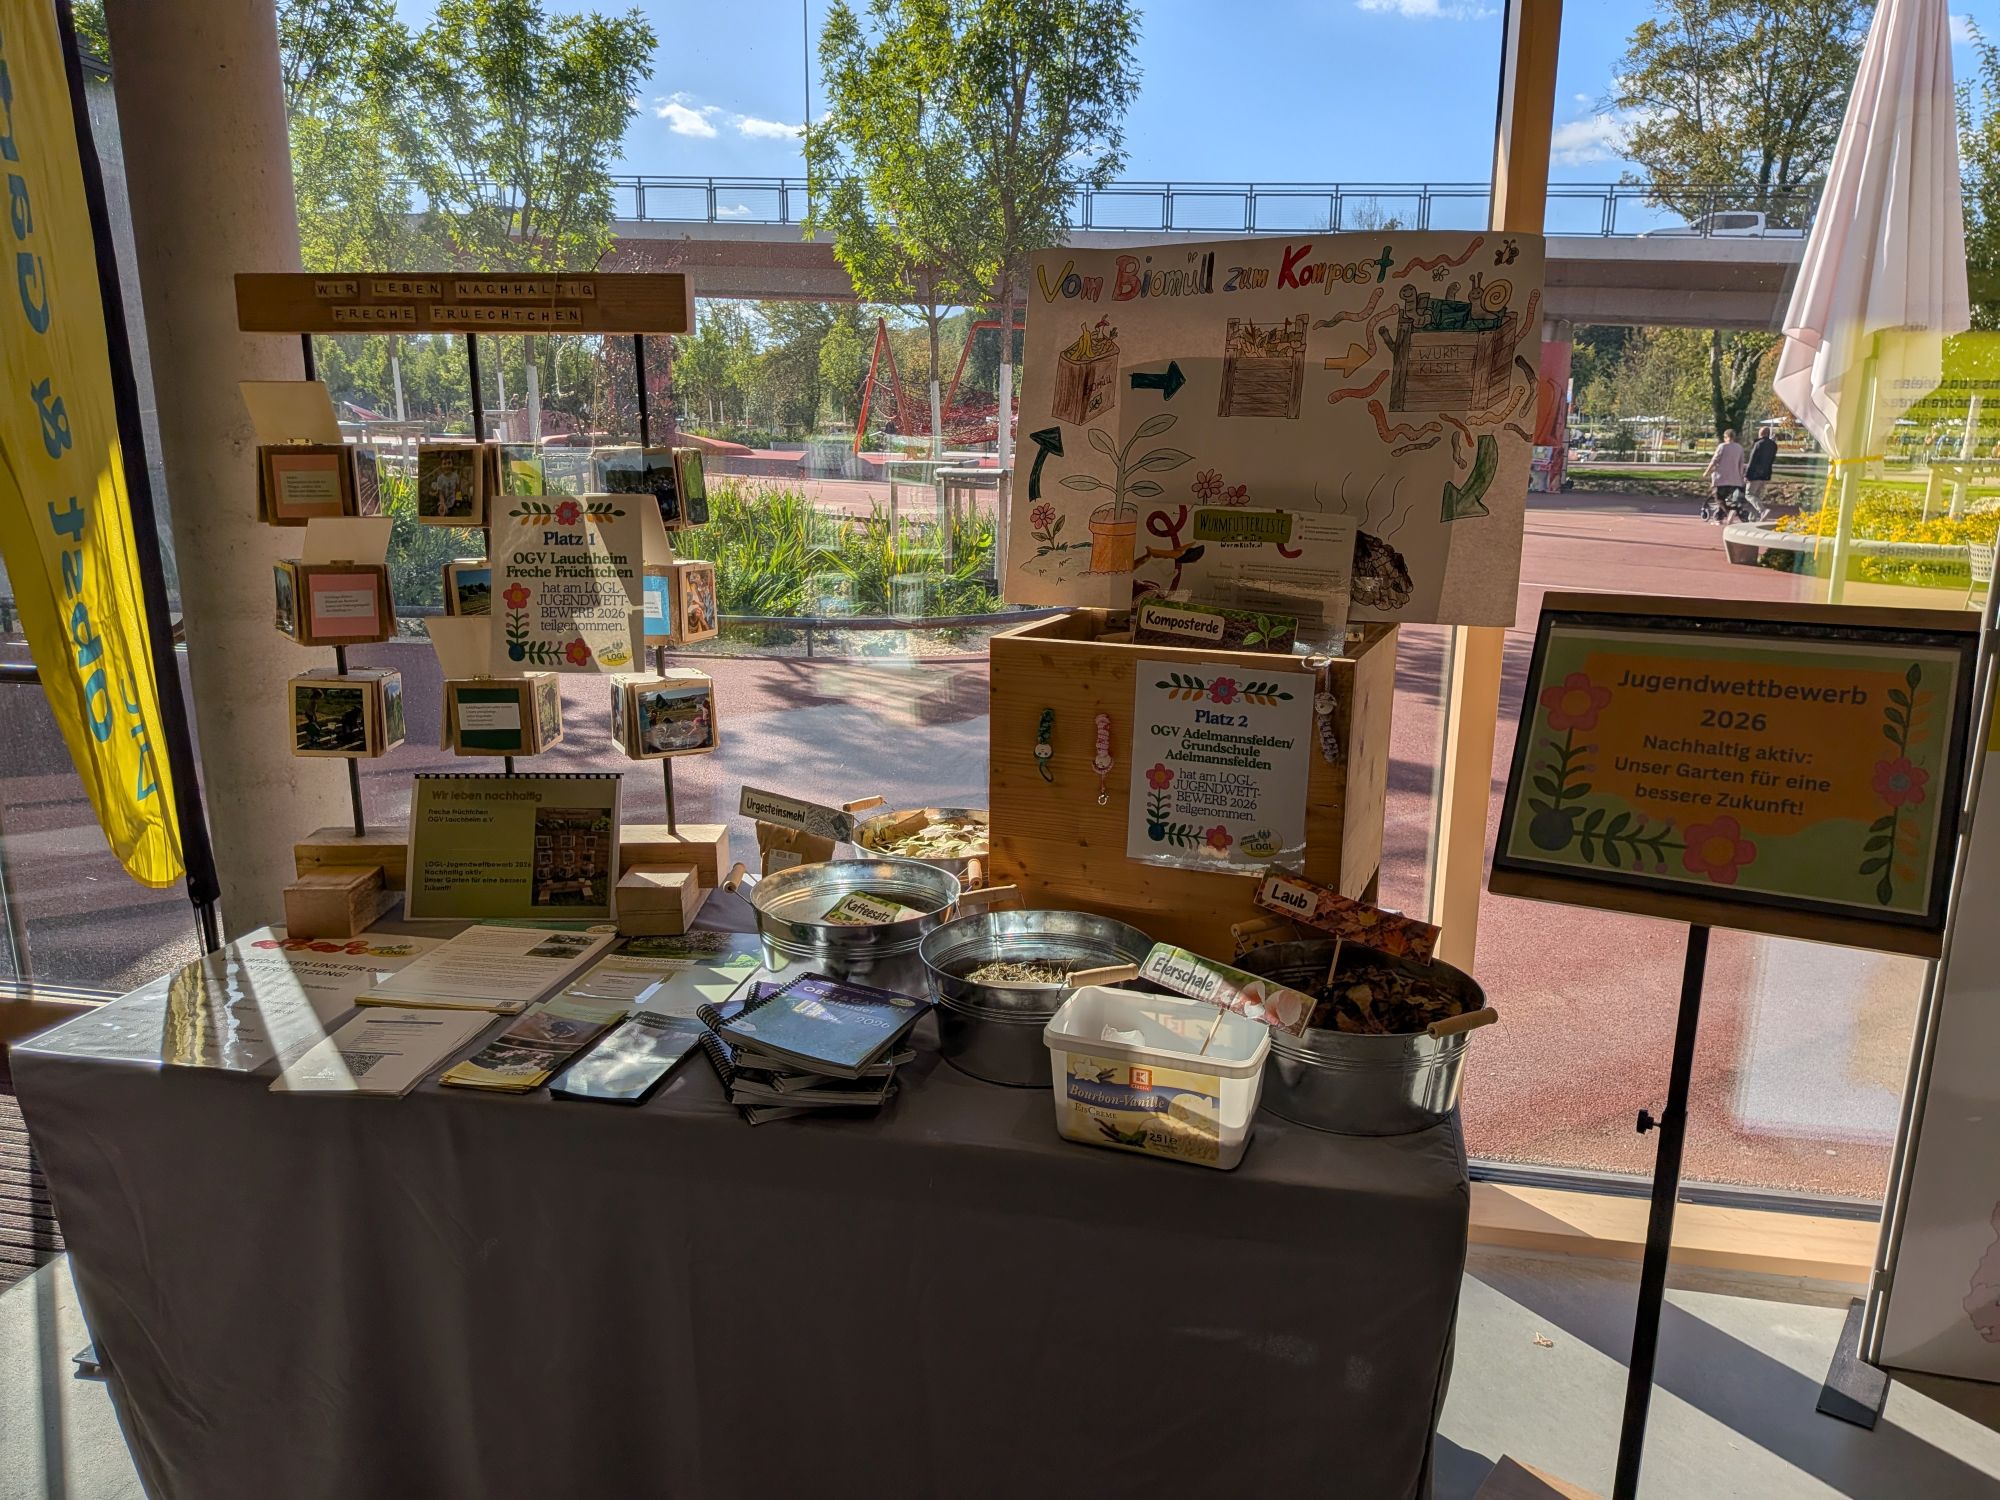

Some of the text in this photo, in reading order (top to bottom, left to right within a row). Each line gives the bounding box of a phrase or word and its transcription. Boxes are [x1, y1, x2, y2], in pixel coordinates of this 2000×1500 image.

[1037, 258, 1104, 304] Vom
[1222, 266, 1270, 293] zum
[1277, 243, 1396, 296] Kompost
[316, 282, 592, 297] WIR LEBEN NACHHALTIG
[334, 307, 579, 322] FRECHE FRUECHTCHEN
[1418, 361, 1460, 375] KISTE
[543, 531, 596, 547] Platz 1
[513, 552, 628, 565] OGV Lauchheim
[506, 565, 634, 579] Freche Früchtchen
[542, 582, 624, 594] hat am LOGL-
[537, 594, 629, 606] JUGENDWETT-
[540, 606, 626, 619] BEWERB 2026
[1145, 609, 1220, 635] Komposterde
[540, 619, 626, 634] teilgenommen.
[1618, 671, 1866, 704] Jugendwettbewerb
[1194, 708, 1249, 728] Platz 2
[1699, 709, 1768, 732] 2026
[1150, 724, 1296, 750] OGV Adelmannsfelden/
[1181, 739, 1261, 758] Grundschule
[1642, 733, 1814, 765] Nachhaltig aktiv:
[1165, 748, 1272, 771] Adelmannsfelden
[1179, 768, 1257, 787] hat am LOGL-
[1614, 756, 1831, 793] Unser Garten für eine
[432, 790, 543, 803] Wir leben nachhaltig
[1173, 780, 1262, 798] JUGENDWETT-
[1176, 791, 1258, 810] BEWERB 2026
[1634, 782, 1805, 816] bessere Zukunft!
[745, 797, 806, 824] Urgesteinsmehl
[1175, 803, 1256, 822] teilgenommen.
[1270, 882, 1309, 911] Laub
[843, 898, 891, 923] Kaffeesatz
[1152, 957, 1215, 993] Eierschale
[1069, 1083, 1165, 1109] Bourbon-Vanille
